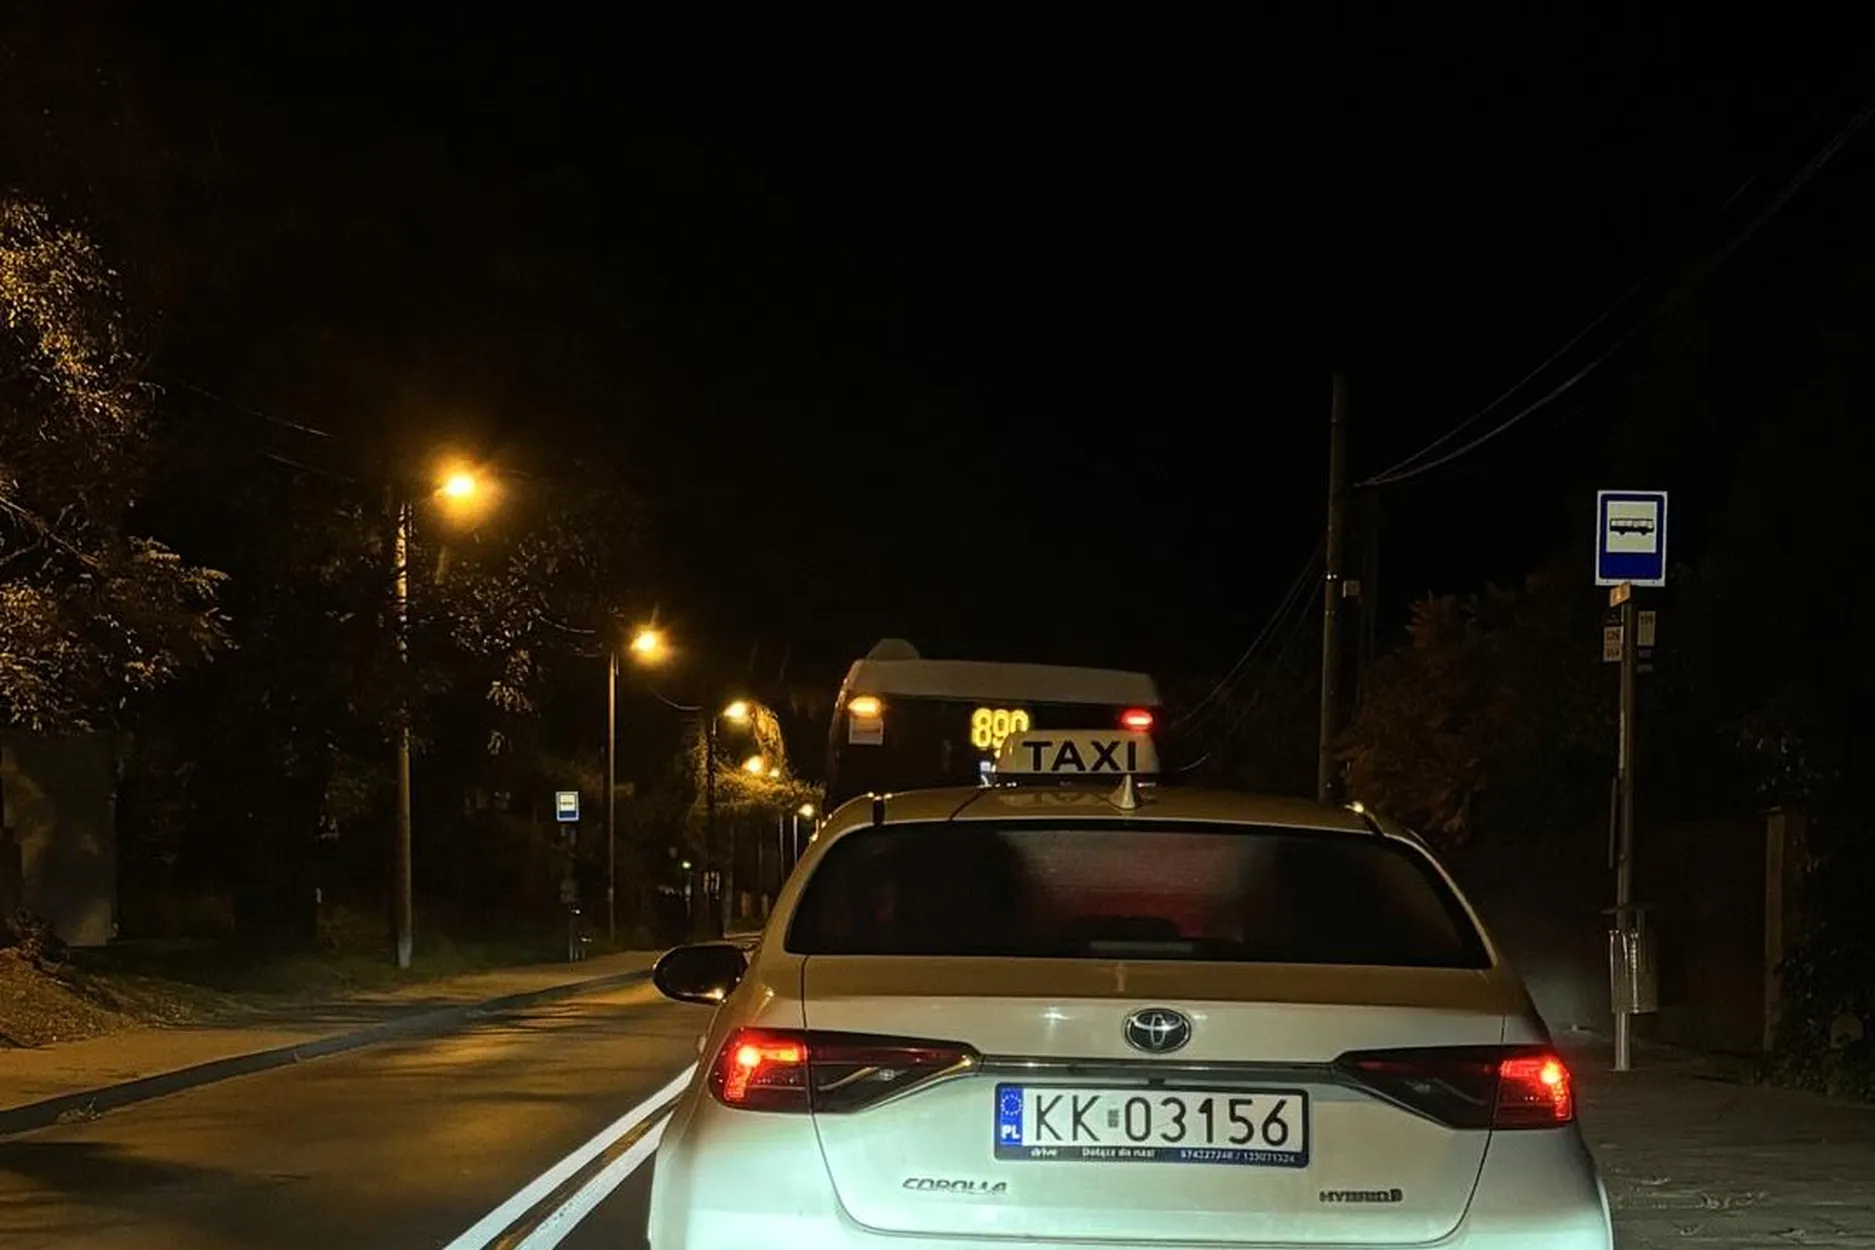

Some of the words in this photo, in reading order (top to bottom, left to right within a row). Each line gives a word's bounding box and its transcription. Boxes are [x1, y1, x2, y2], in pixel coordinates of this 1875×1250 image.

[1022, 740, 1137, 771] TAXI
[1035, 1094, 1101, 1141] KK
[1124, 1096, 1289, 1146] 03156
[1001, 1125, 1020, 1138] PL
[902, 1177, 1007, 1194] COROLLA
[1319, 1190, 1389, 1203] HYBRID
